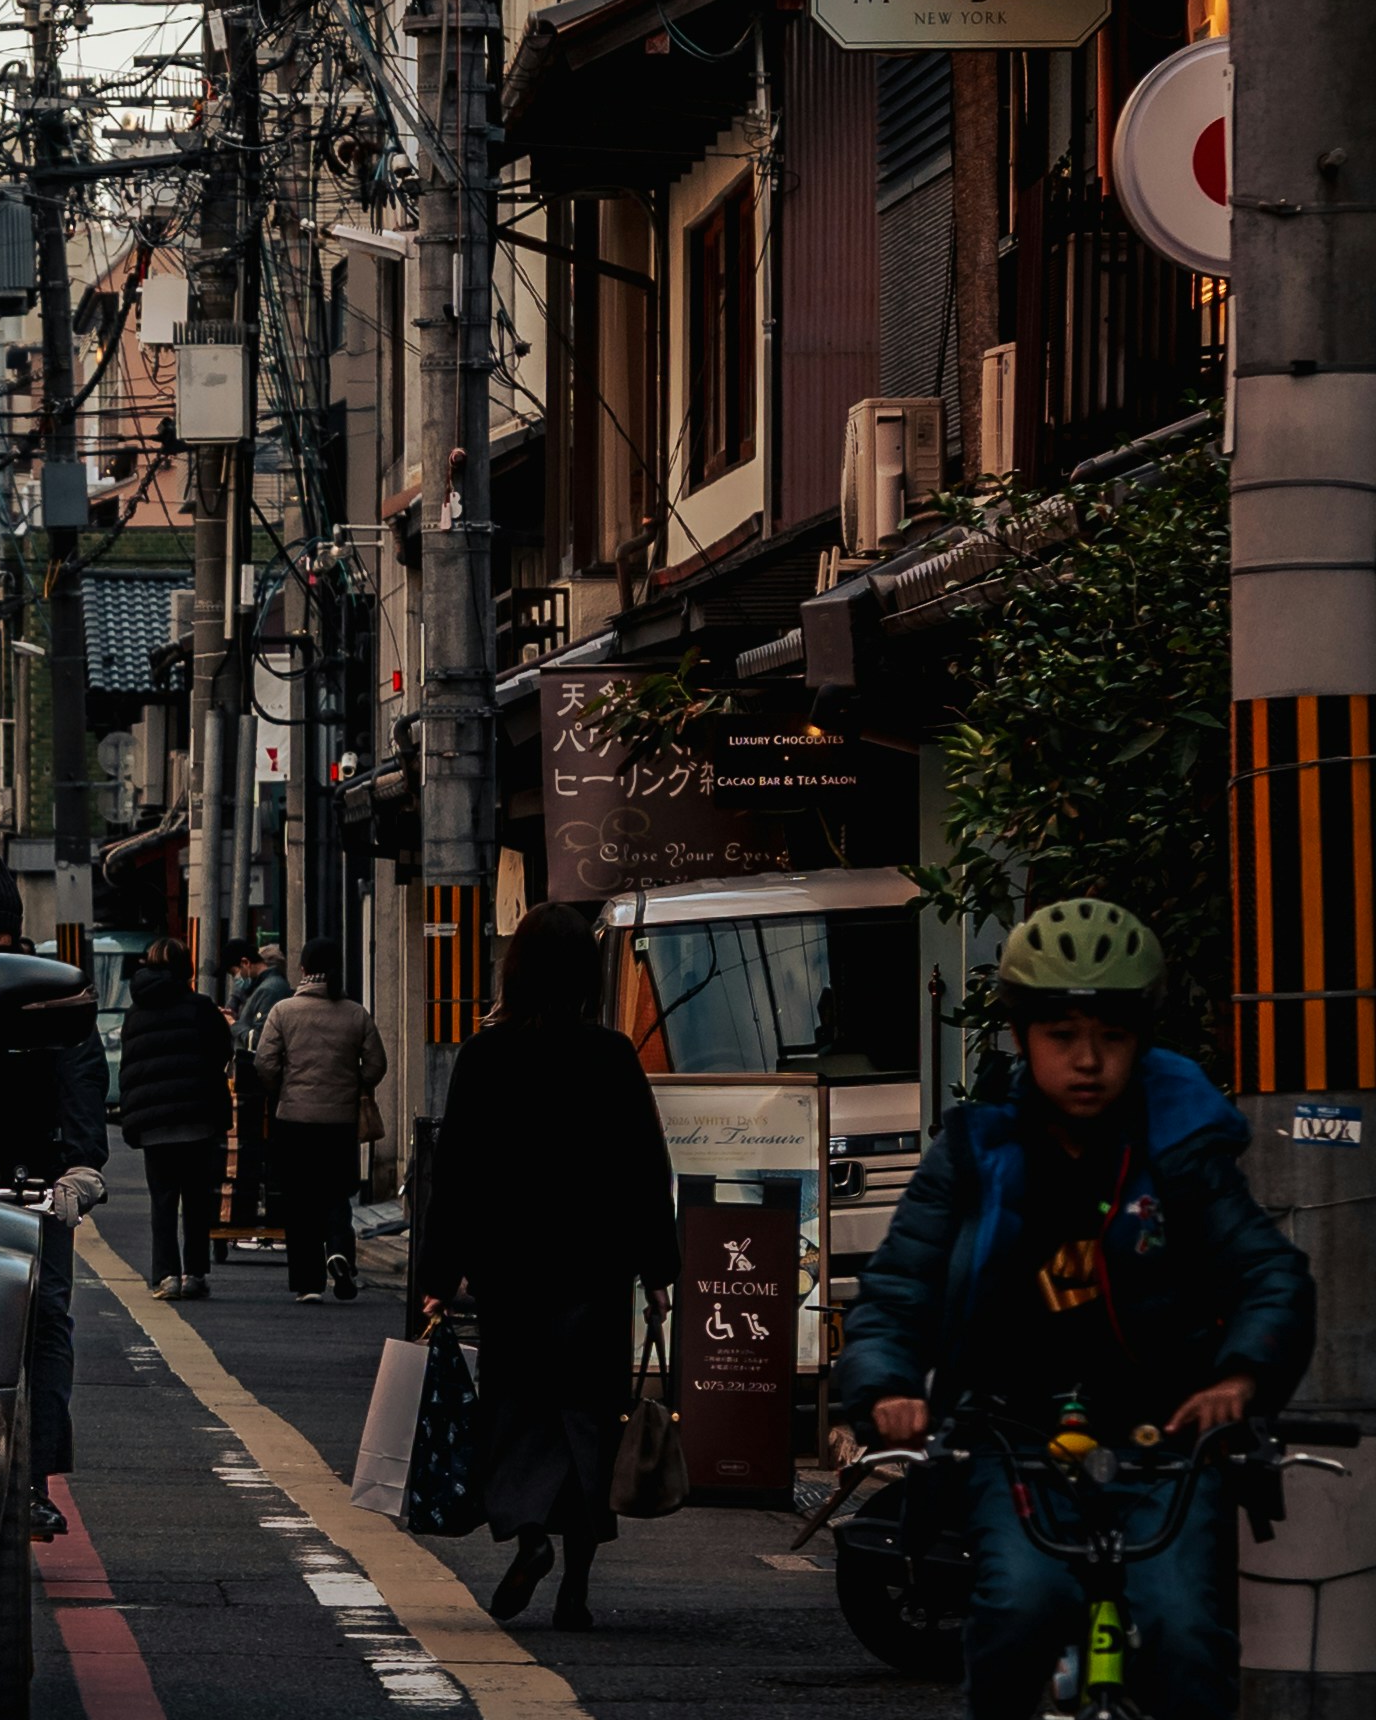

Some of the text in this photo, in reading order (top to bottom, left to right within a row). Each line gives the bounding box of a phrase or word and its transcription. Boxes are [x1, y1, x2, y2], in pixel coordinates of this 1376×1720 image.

[914, 11, 1007, 25] NEW YORK
[728, 734, 845, 746] LUXURY CHOCOLATES
[717, 774, 857, 787] CACAO BAR & TEA SALON
[599, 842, 770, 870] Close Your Eyes
[715, 1126, 805, 1146] Treasure
[697, 1280, 779, 1297] WELCOME
